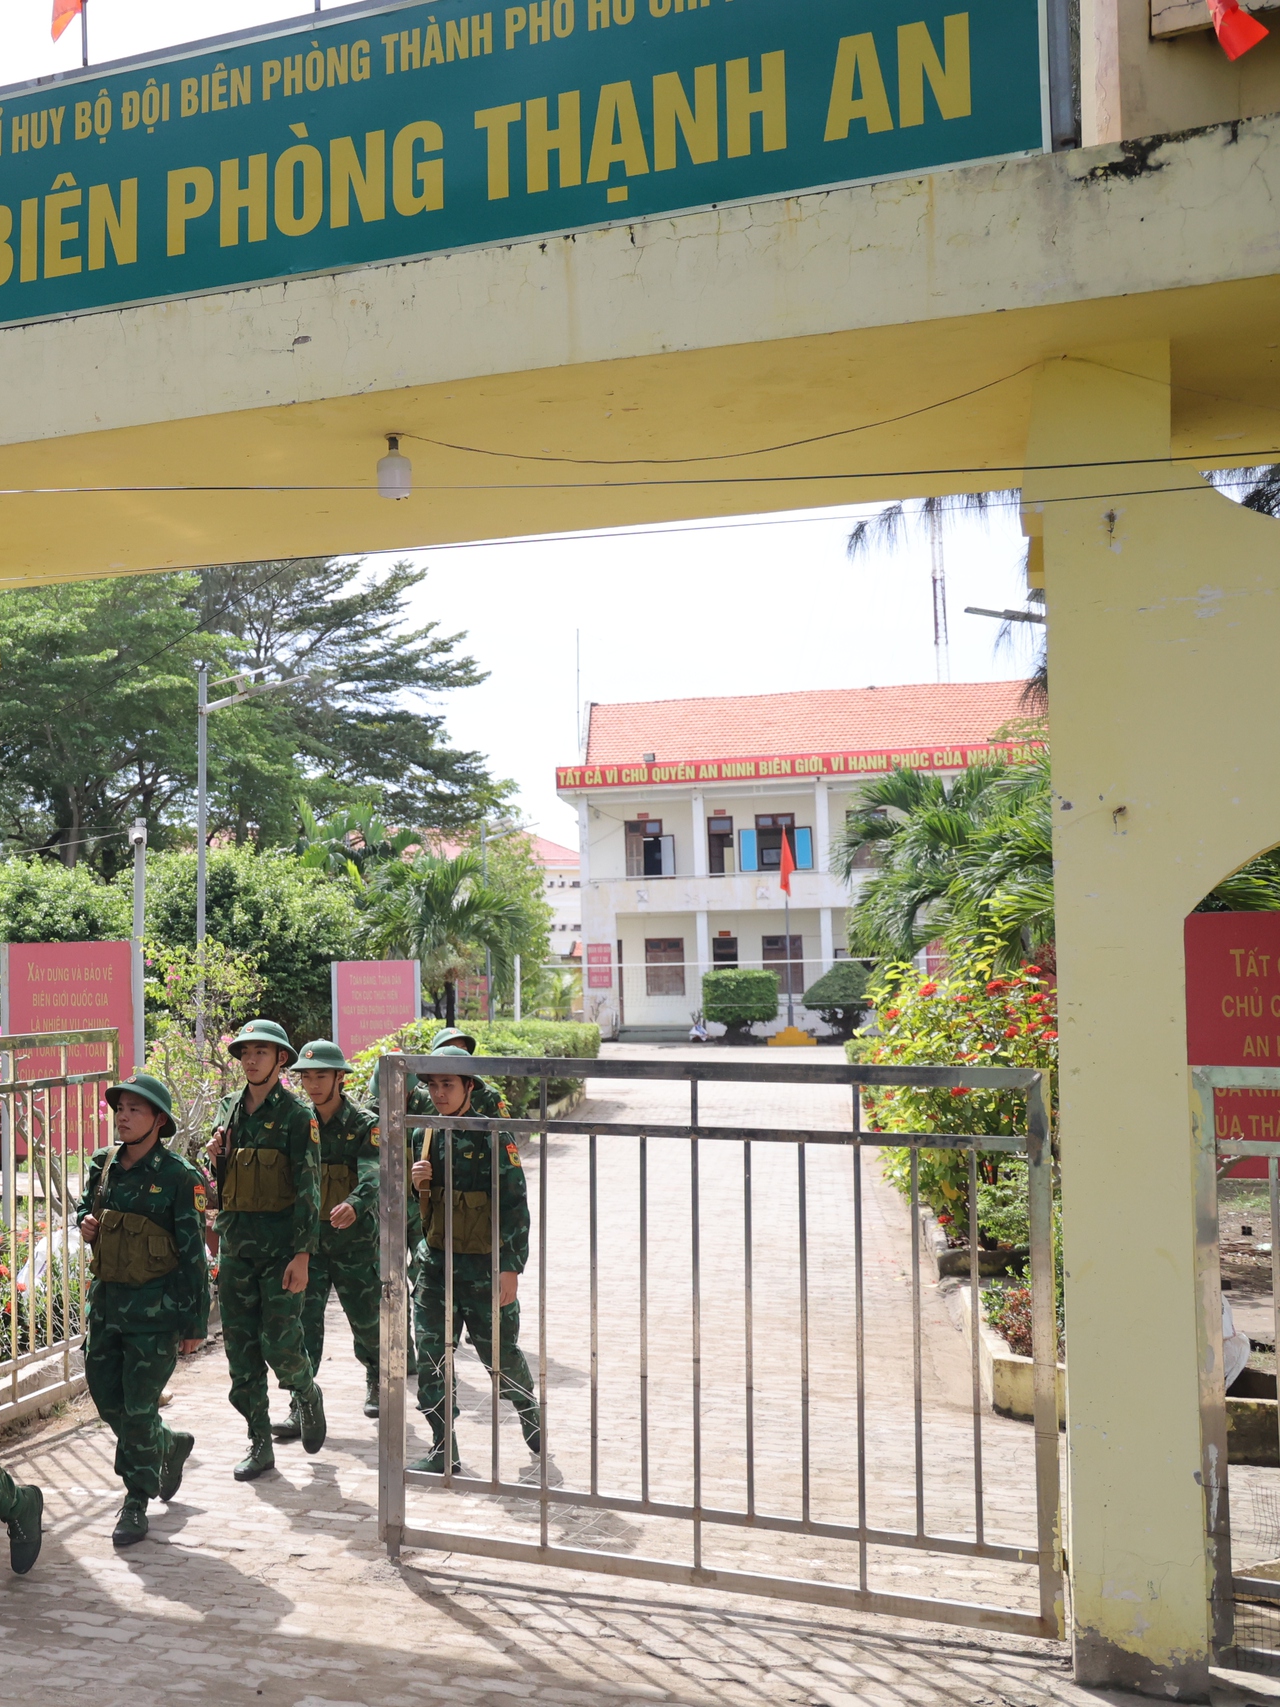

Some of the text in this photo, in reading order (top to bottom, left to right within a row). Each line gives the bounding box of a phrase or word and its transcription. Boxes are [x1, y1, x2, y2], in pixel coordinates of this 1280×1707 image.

[11, 105, 65, 153] HUY
[74, 88, 113, 145] BỘ
[121, 78, 170, 134] ĐỘI
[180, 62, 252, 119] BIÊN
[262, 40, 371, 103] PHÒNG
[381, 12, 493, 75] THÀNH
[166, 120, 444, 257] PHÒNG
[475, 49, 787, 203] THẠNH
[823, 12, 972, 142] AN
[558, 766, 581, 786] TẤT
[584, 765, 603, 784] CẢ
[605, 767, 619, 784] VÌ
[622, 763, 649, 782] CHỦ
[651, 761, 696, 782] QUYỀN
[699, 764, 718, 779] AN
[722, 761, 756, 777] NINH
[759, 757, 791, 775] BIÊN
[795, 755, 827, 774] GIỚI,
[830, 753, 845, 771] VÌ
[848, 754, 887, 773] HẠNH
[890, 749, 929, 768] PHÚC
[933, 747, 963, 766] CỦA
[71, 964, 82, 981] VÀ
[1229, 946, 1270, 977] TẤT
[32, 990, 51, 1007] BIÊN
[70, 987, 93, 1007] QUỐC
[95, 993, 109, 1006] GIA
[1221, 986, 1263, 1018] CHỦ
[1243, 1035, 1270, 1057] AN
[1215, 1106, 1243, 1137] ỦA
